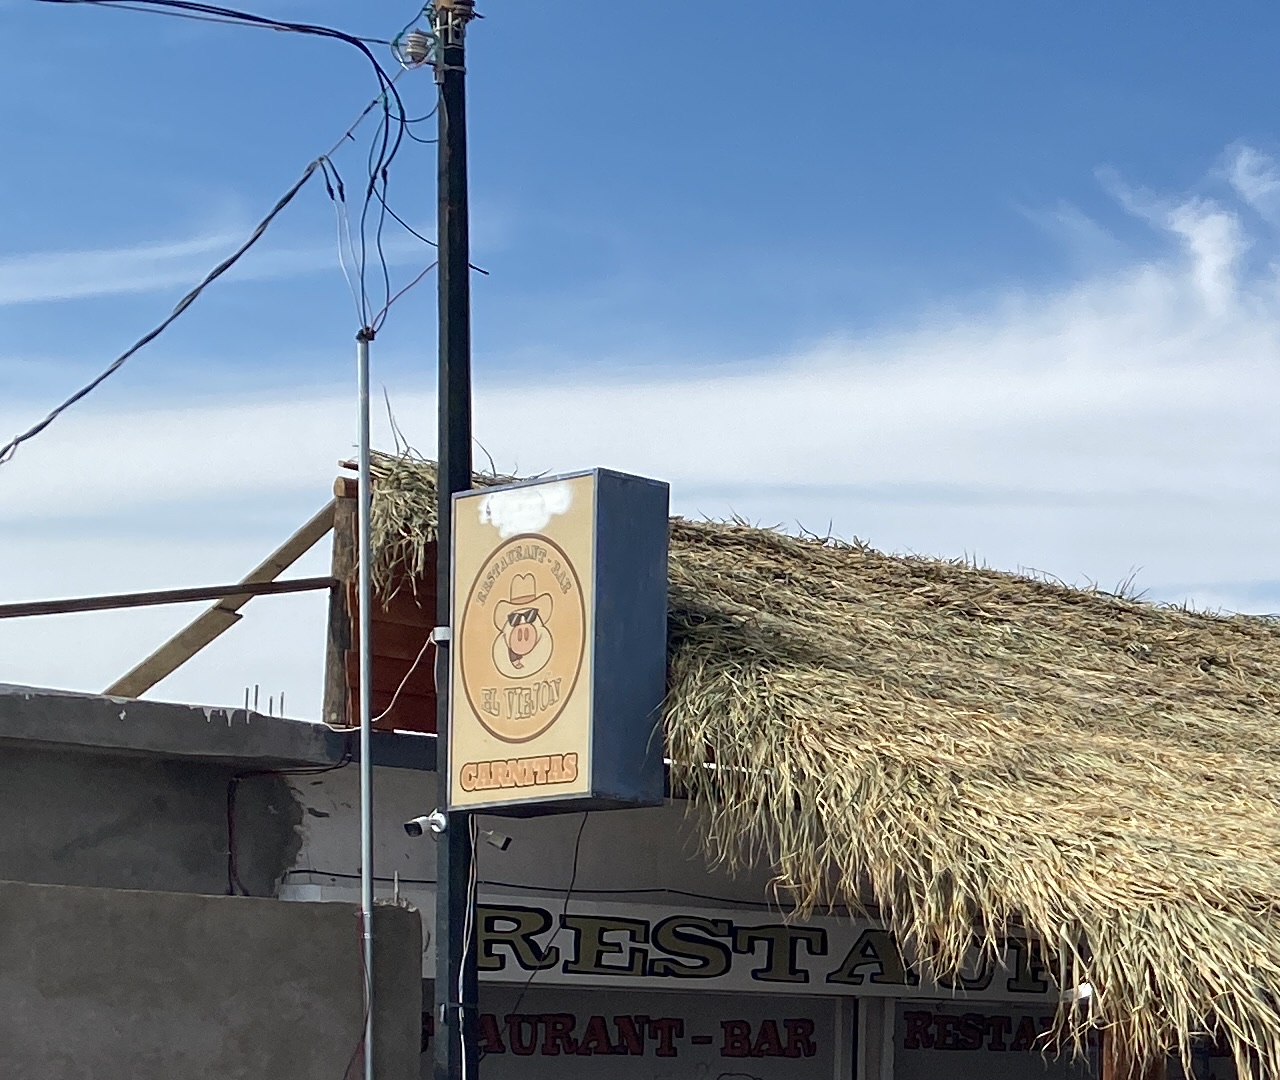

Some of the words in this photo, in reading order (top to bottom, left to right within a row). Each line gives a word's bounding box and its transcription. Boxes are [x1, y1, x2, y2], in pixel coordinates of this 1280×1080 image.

[550, 560, 572, 595] BAR
[481, 687, 500, 717] EL
[459, 752, 579, 793] CARNITAS
[720, 1018, 817, 1058] BAR
